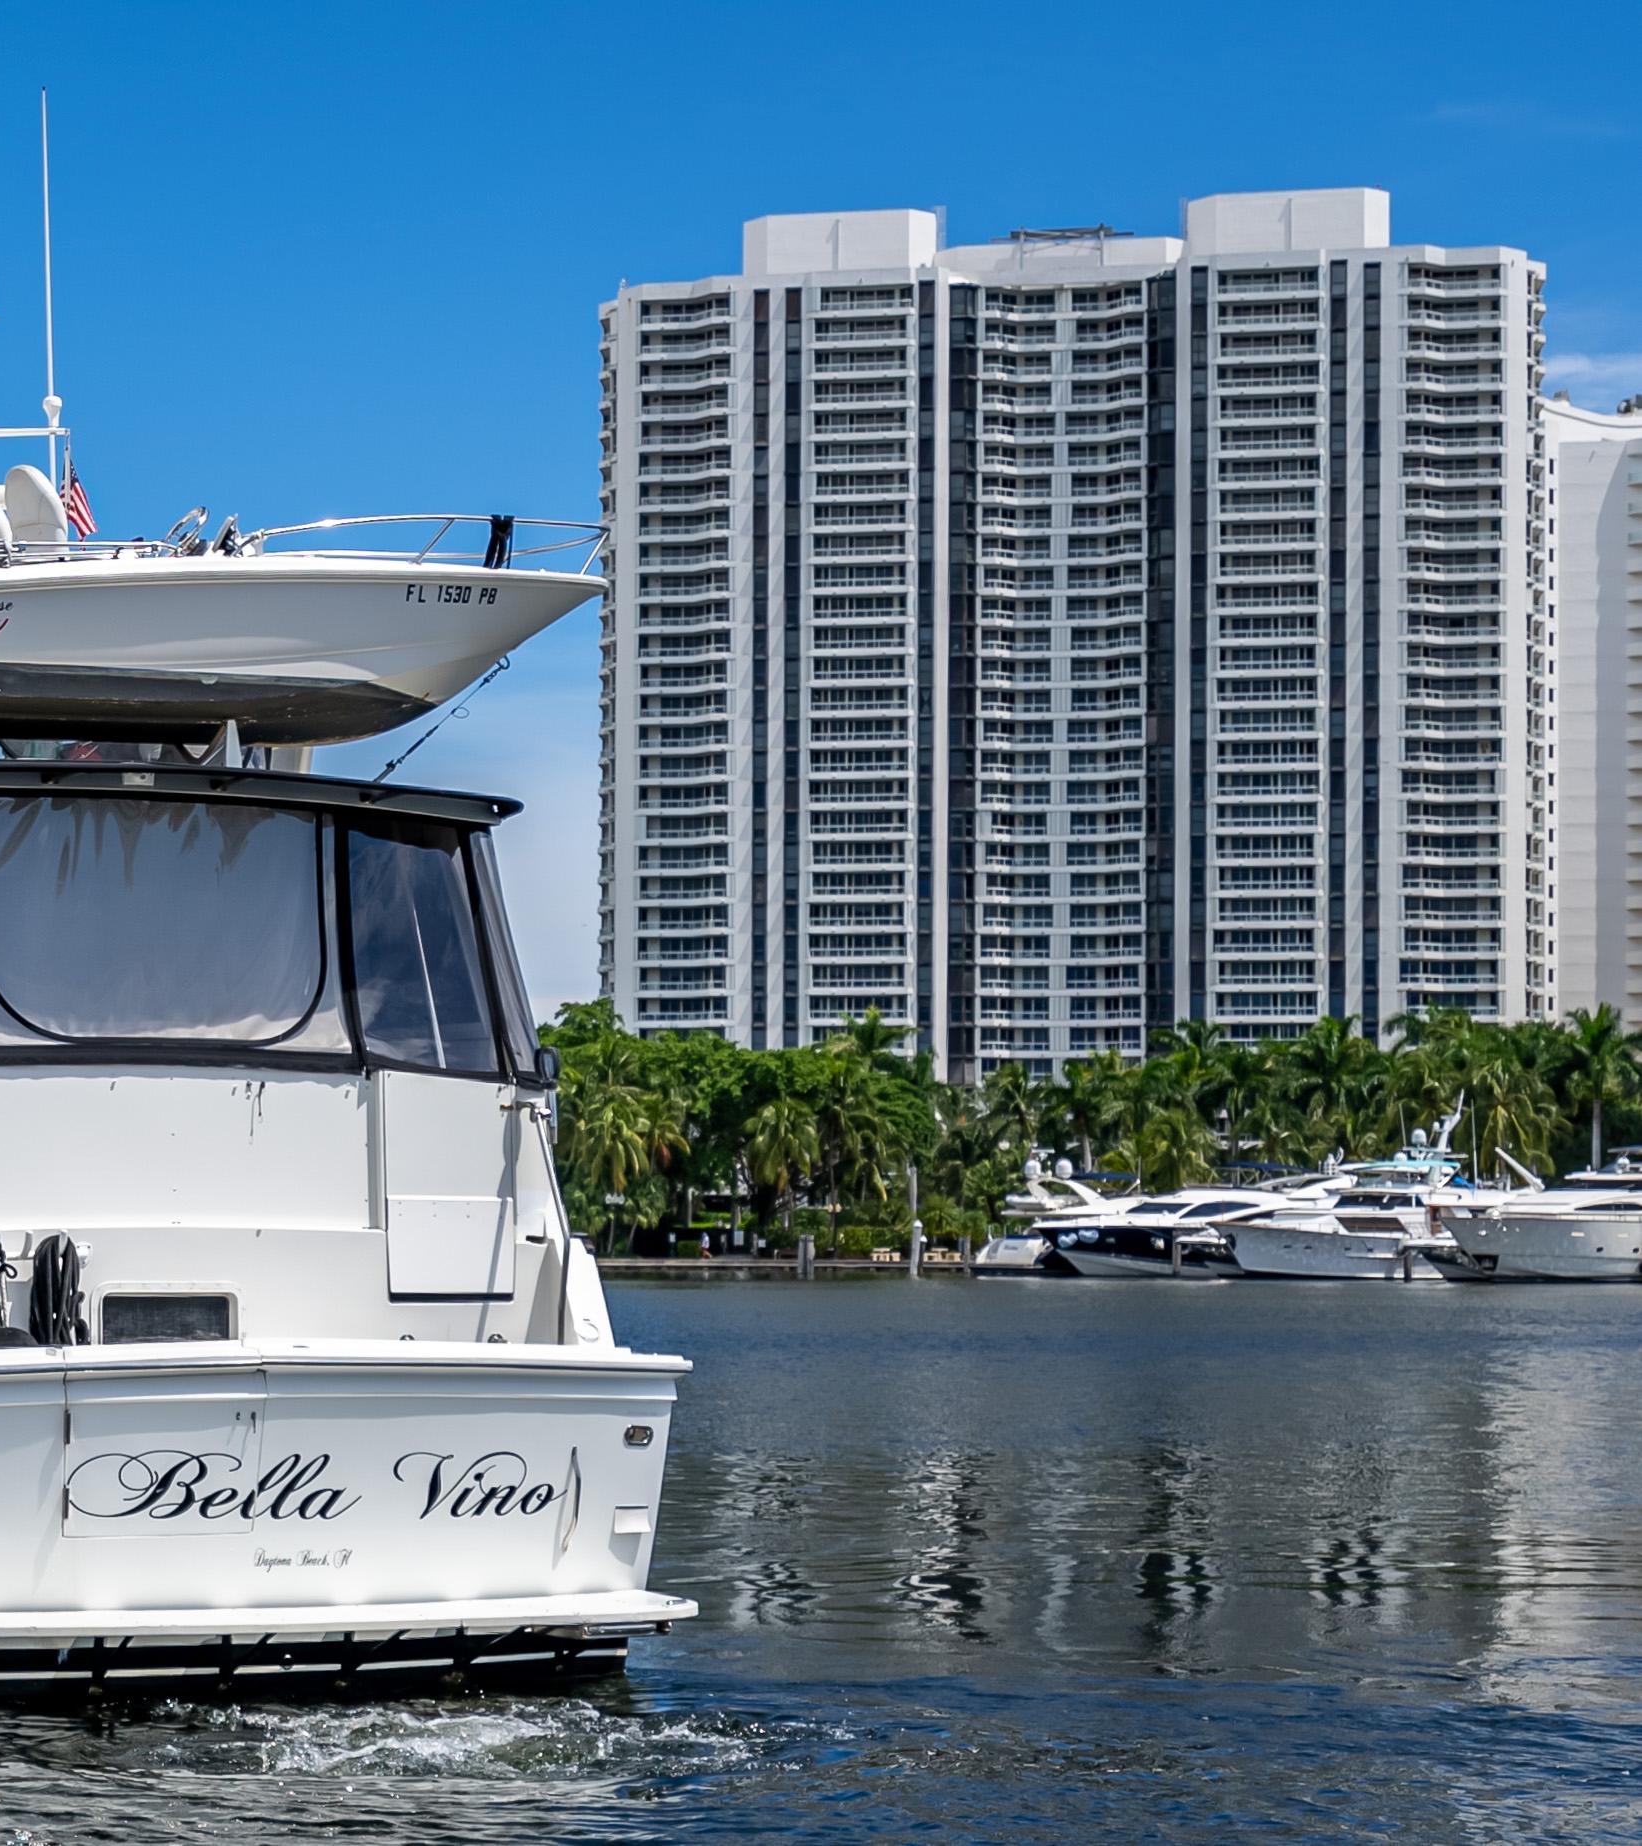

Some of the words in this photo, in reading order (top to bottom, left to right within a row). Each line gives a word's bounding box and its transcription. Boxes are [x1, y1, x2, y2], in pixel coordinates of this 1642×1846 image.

[405, 583, 426, 603] FL
[437, 584, 472, 604] 1530
[478, 587, 498, 605] PB
[67, 1449, 363, 1520] Bella
[393, 1451, 568, 1520] Vino
